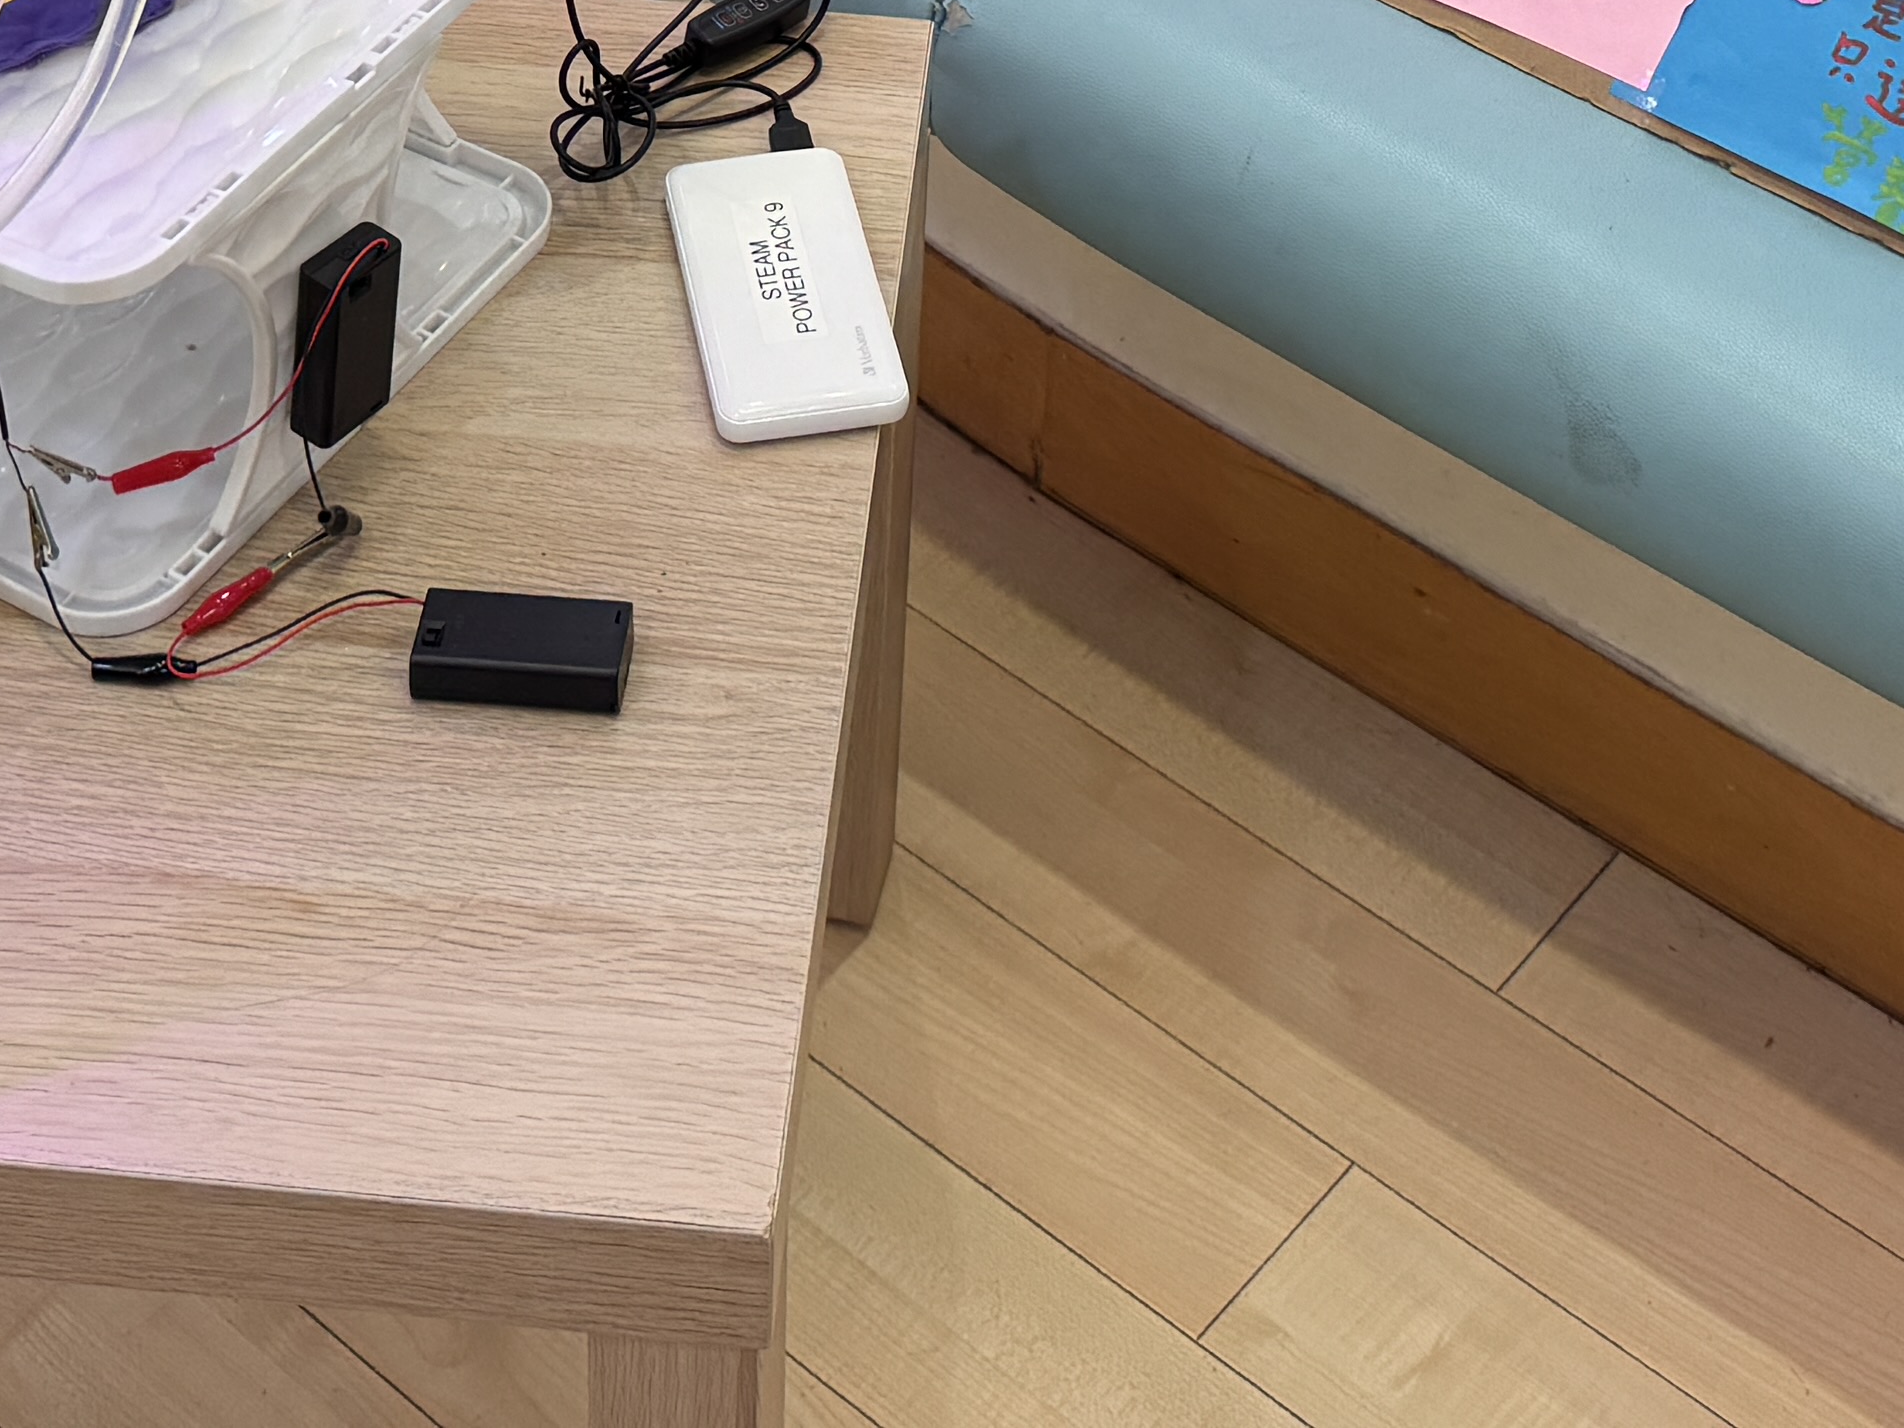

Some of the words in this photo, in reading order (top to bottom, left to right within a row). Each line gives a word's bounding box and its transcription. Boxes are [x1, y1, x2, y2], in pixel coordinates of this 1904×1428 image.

[764, 202, 784, 213] 9
[767, 214, 798, 263] PACK
[749, 239, 782, 301] STEAM
[781, 266, 817, 334] POWER
